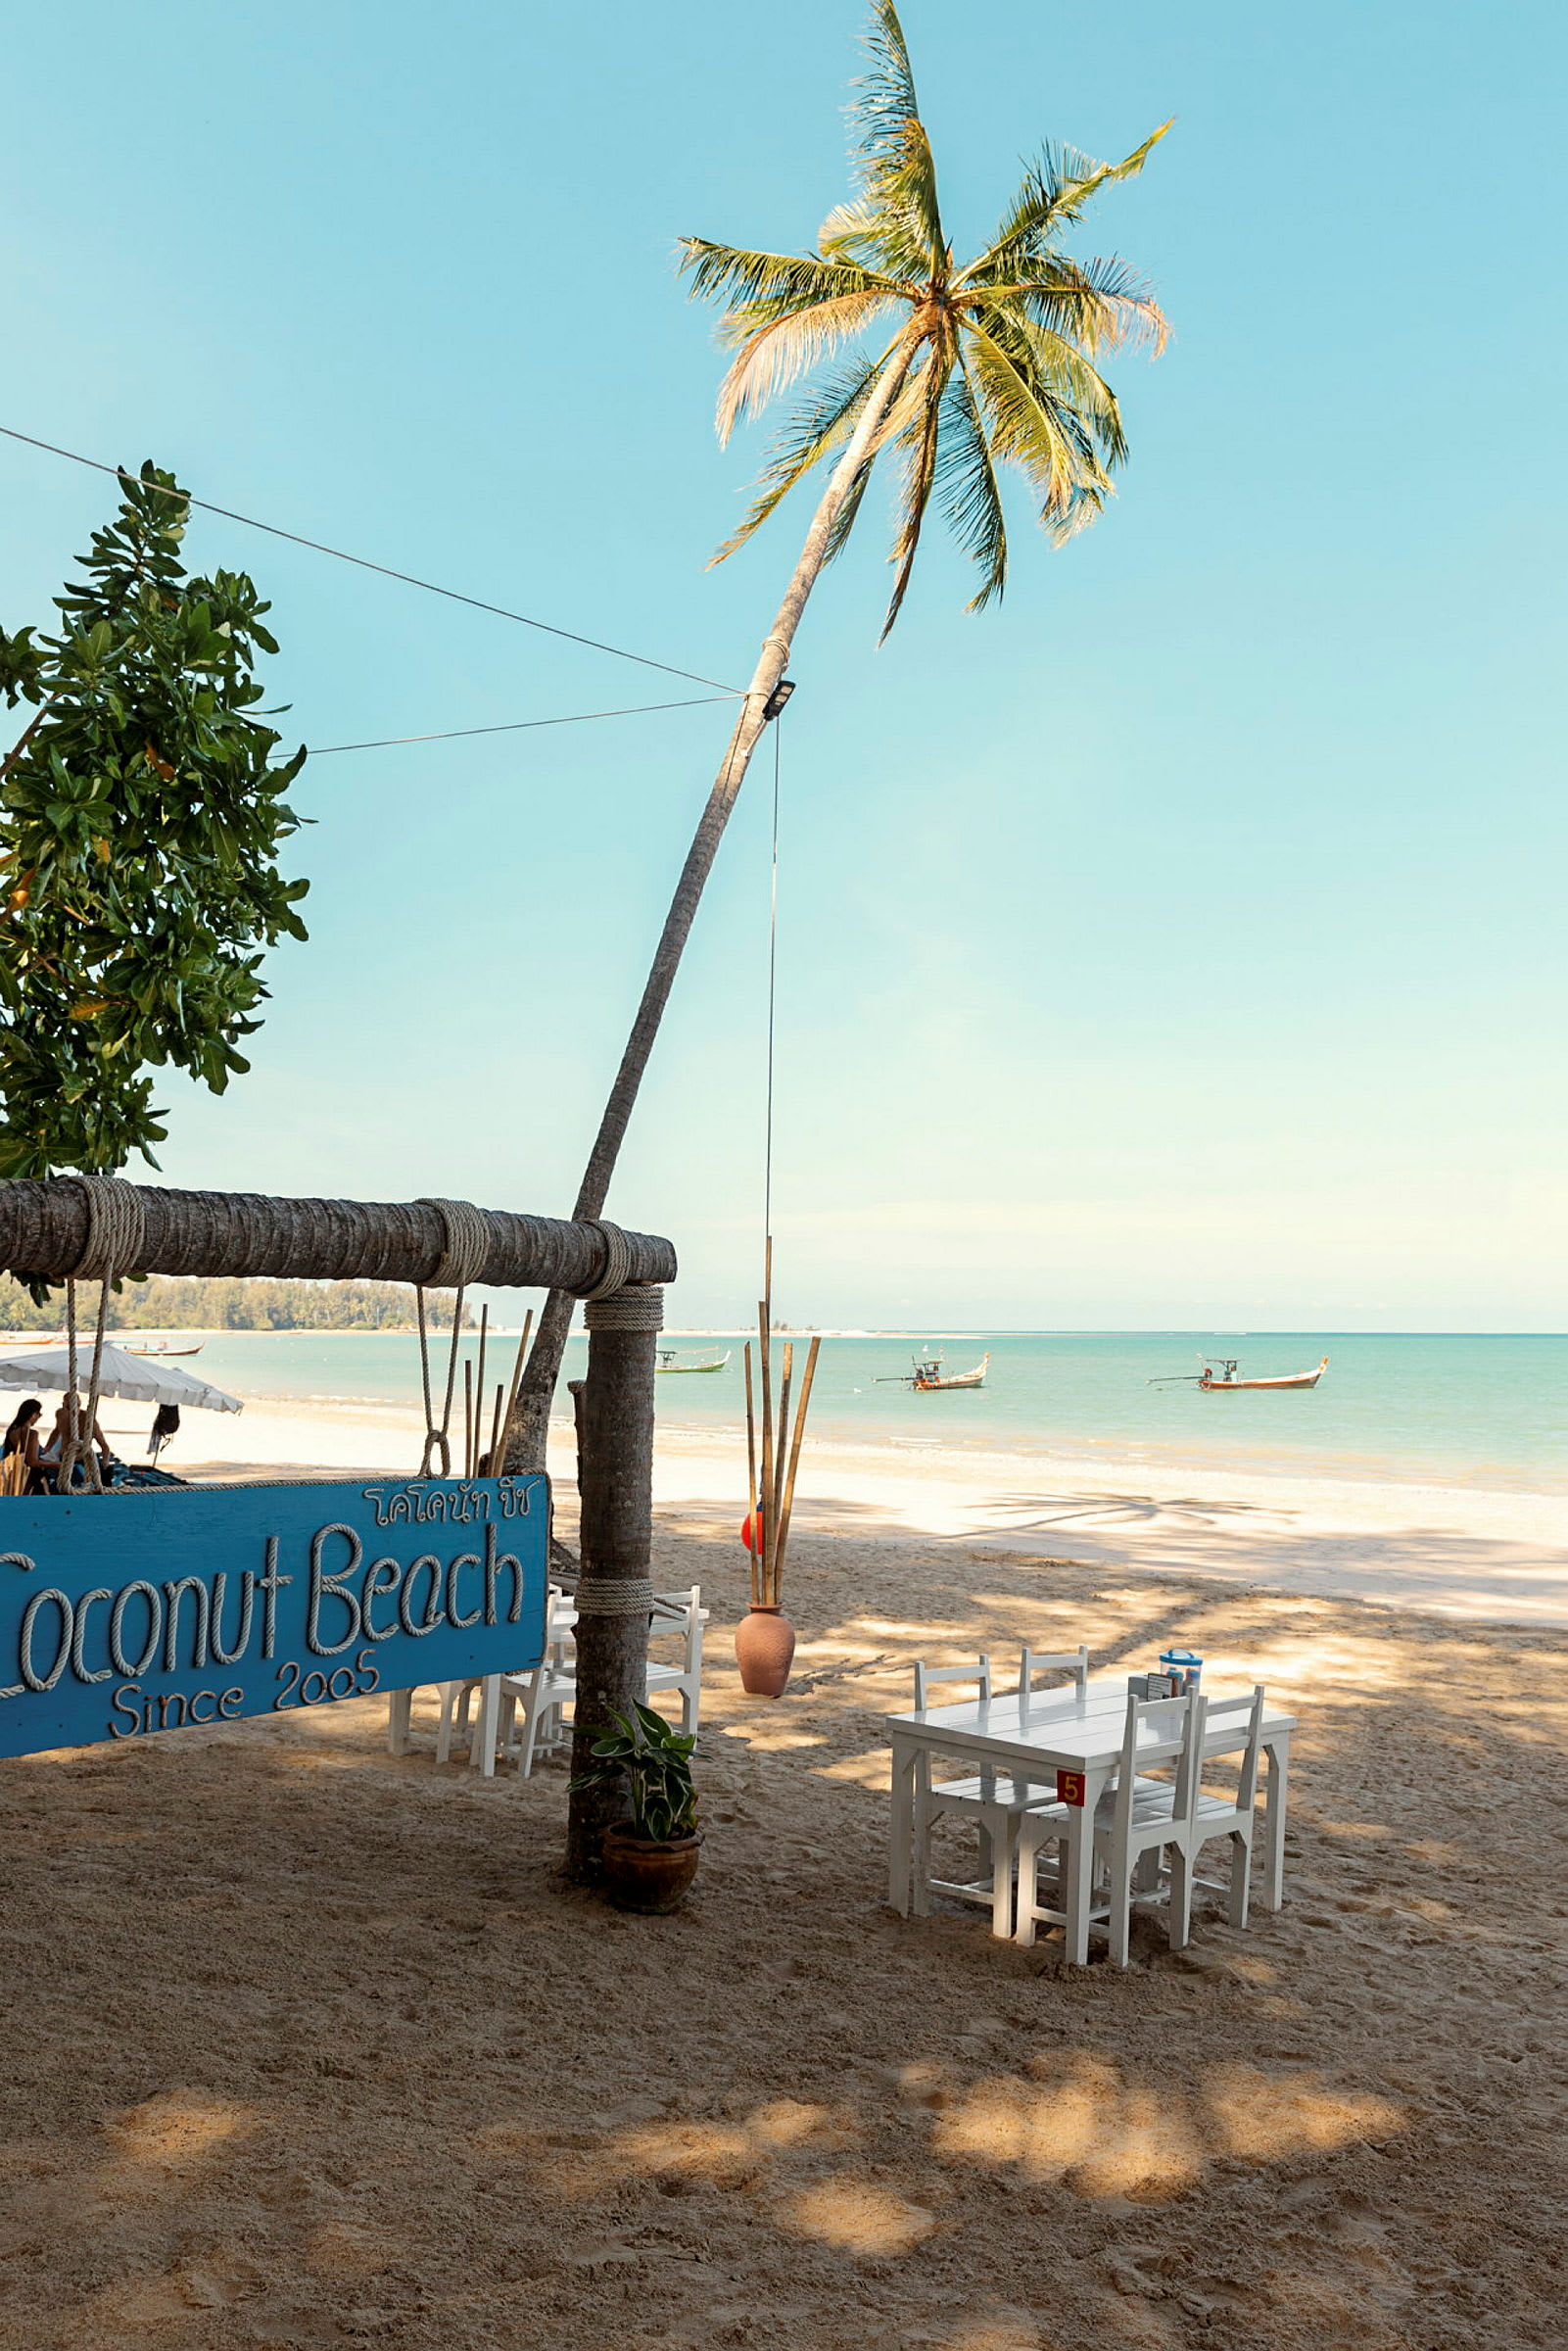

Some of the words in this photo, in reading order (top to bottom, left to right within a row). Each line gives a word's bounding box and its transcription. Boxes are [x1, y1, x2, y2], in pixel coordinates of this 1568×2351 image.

[363, 1480, 491, 1526] โคโคนัท
[308, 1522, 524, 1655] Beach
[109, 1684, 244, 1738] Since
[274, 1649, 380, 1709] 2005
[1065, 1776, 1078, 1800] 5
